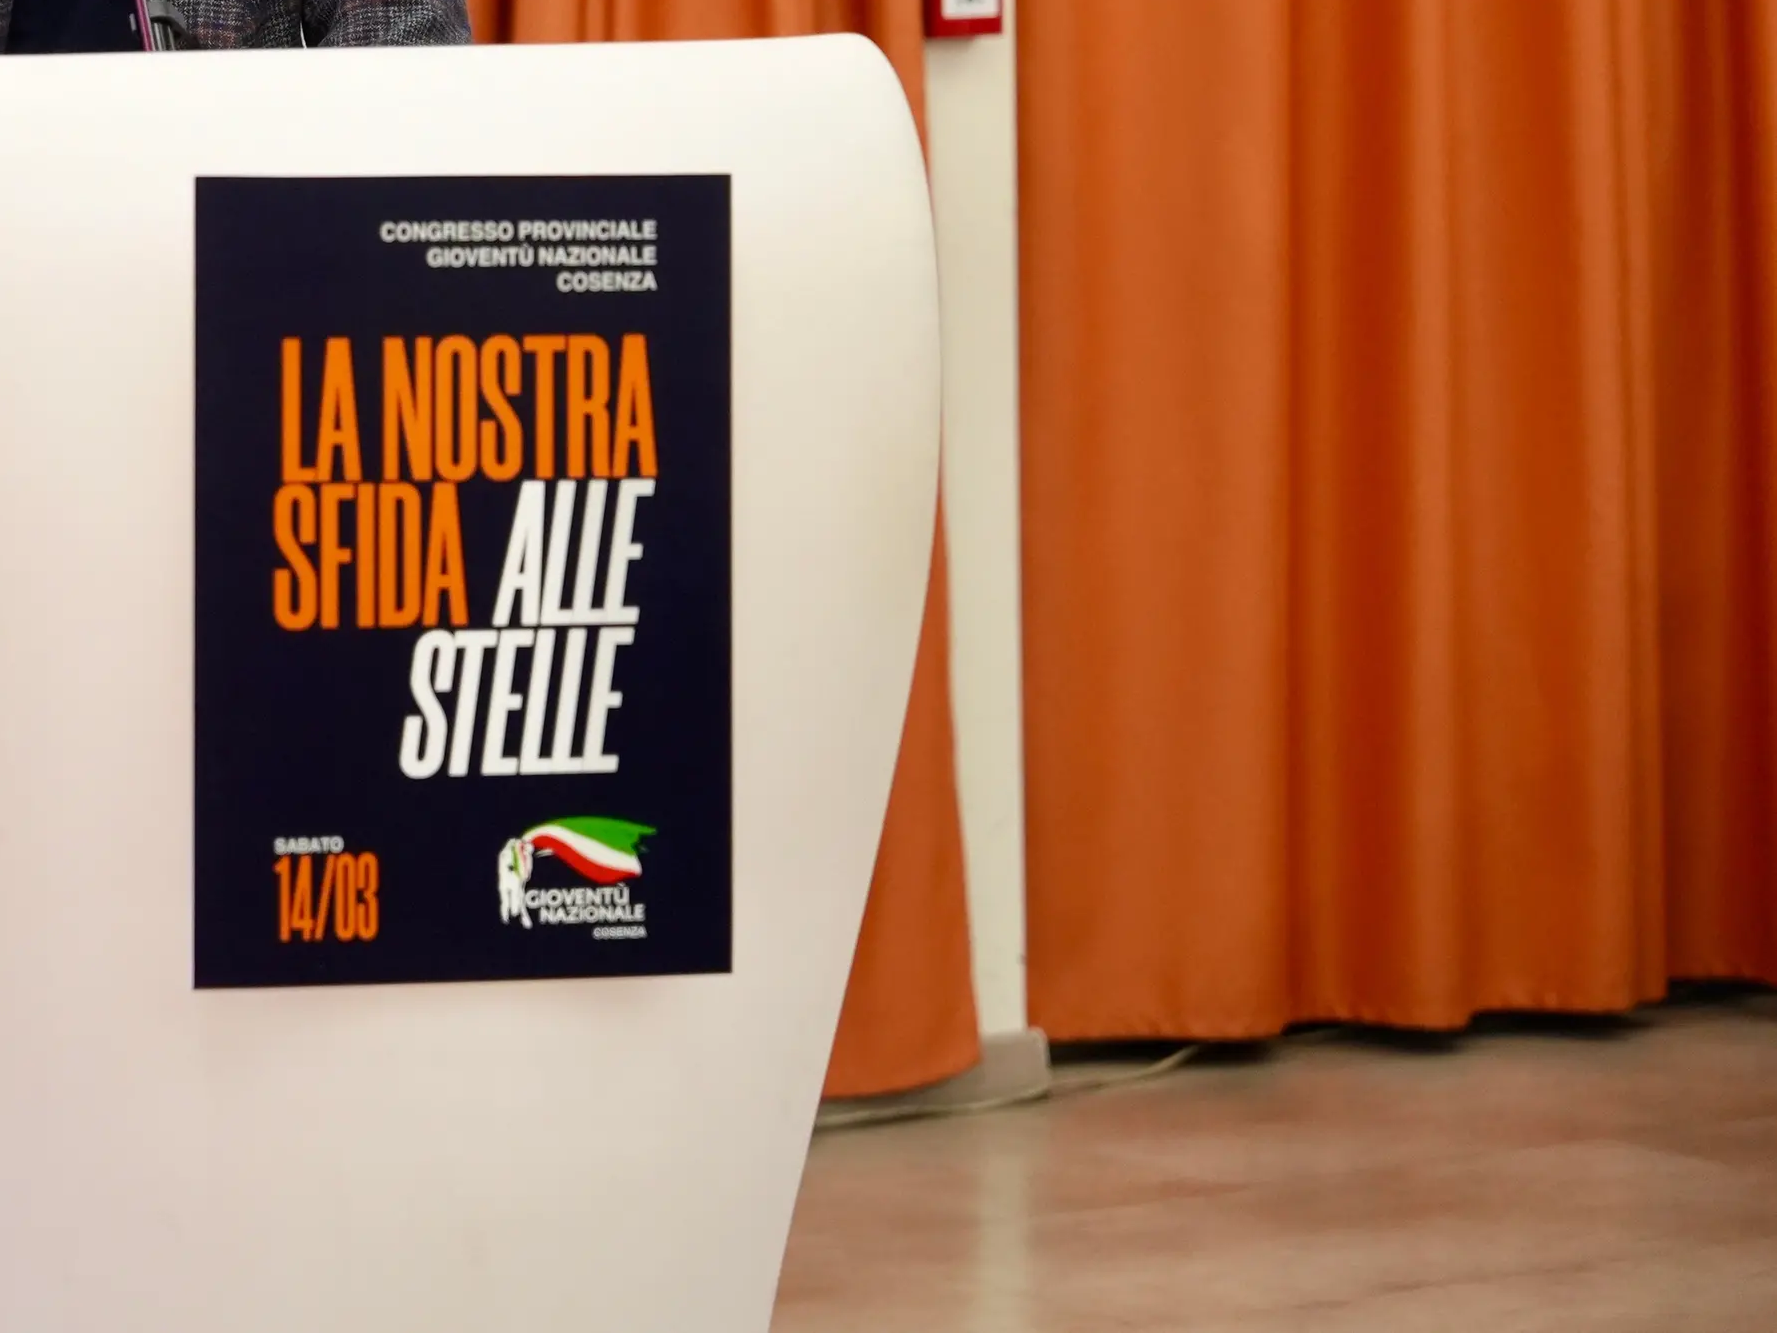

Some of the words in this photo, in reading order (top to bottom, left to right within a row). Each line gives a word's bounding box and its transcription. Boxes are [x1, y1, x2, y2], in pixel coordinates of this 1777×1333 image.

[379, 219, 515, 243] CONGRESSO
[517, 219, 658, 241] PROVINCIALE
[426, 244, 535, 268] GIOVENTÙ
[537, 245, 658, 267] NAZIONALE
[556, 270, 658, 293] COSENZA
[281, 336, 363, 483] LA
[382, 333, 659, 482] NOSTRA
[272, 481, 470, 631] SFIDA
[491, 477, 657, 627] ALLE
[398, 626, 636, 780] STELLE
[274, 835, 345, 855] SABATO
[273, 851, 379, 942] 14/03
[524, 883, 631, 909] GIOVENTÙ
[538, 903, 646, 924] NAZIONALE
[592, 925, 648, 940] COSENZA
